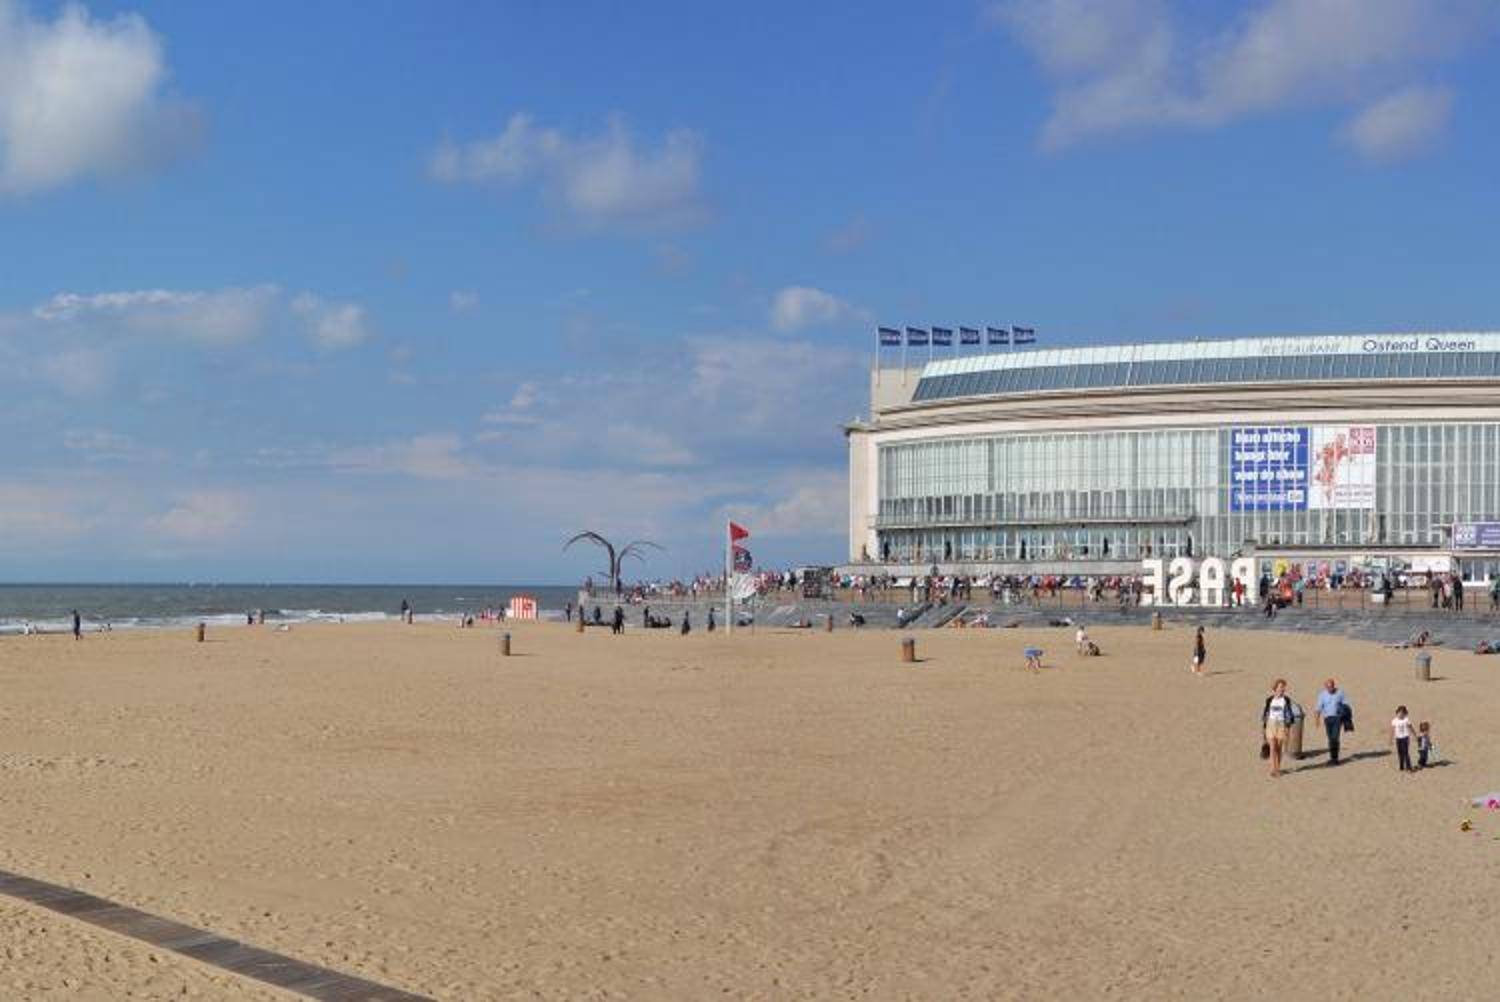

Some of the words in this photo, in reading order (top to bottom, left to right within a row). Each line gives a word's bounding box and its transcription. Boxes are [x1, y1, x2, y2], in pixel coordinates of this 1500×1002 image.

[1363, 338, 1418, 351] Ostend
[1426, 337, 1475, 351] Queen
[1260, 469, 1274, 480] de
